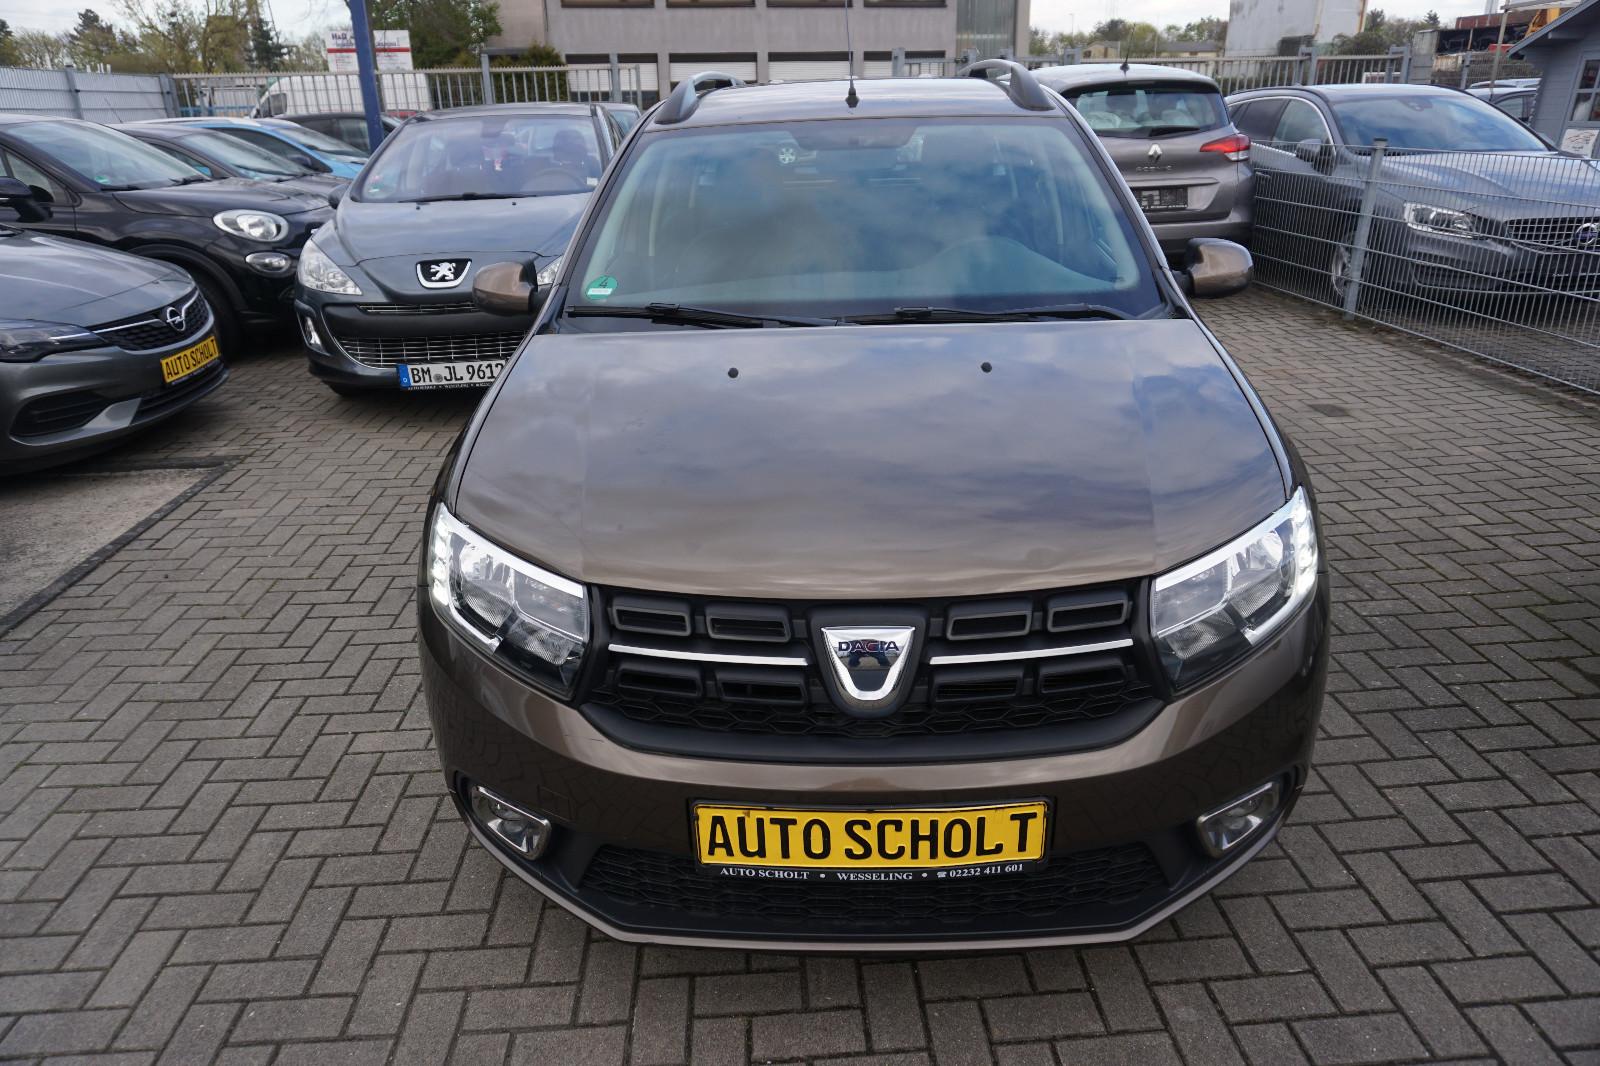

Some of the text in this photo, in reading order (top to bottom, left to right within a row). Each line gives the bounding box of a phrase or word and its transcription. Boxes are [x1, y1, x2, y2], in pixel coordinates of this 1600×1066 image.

[165, 354, 190, 379] AUTO
[410, 367, 432, 383] BM
[444, 366, 463, 381] JL
[838, 640, 900, 653] DACIA
[707, 815, 831, 860] AUTO
[720, 863, 1024, 881] AUTO SCHOLT WESSELING 02232 411 601
